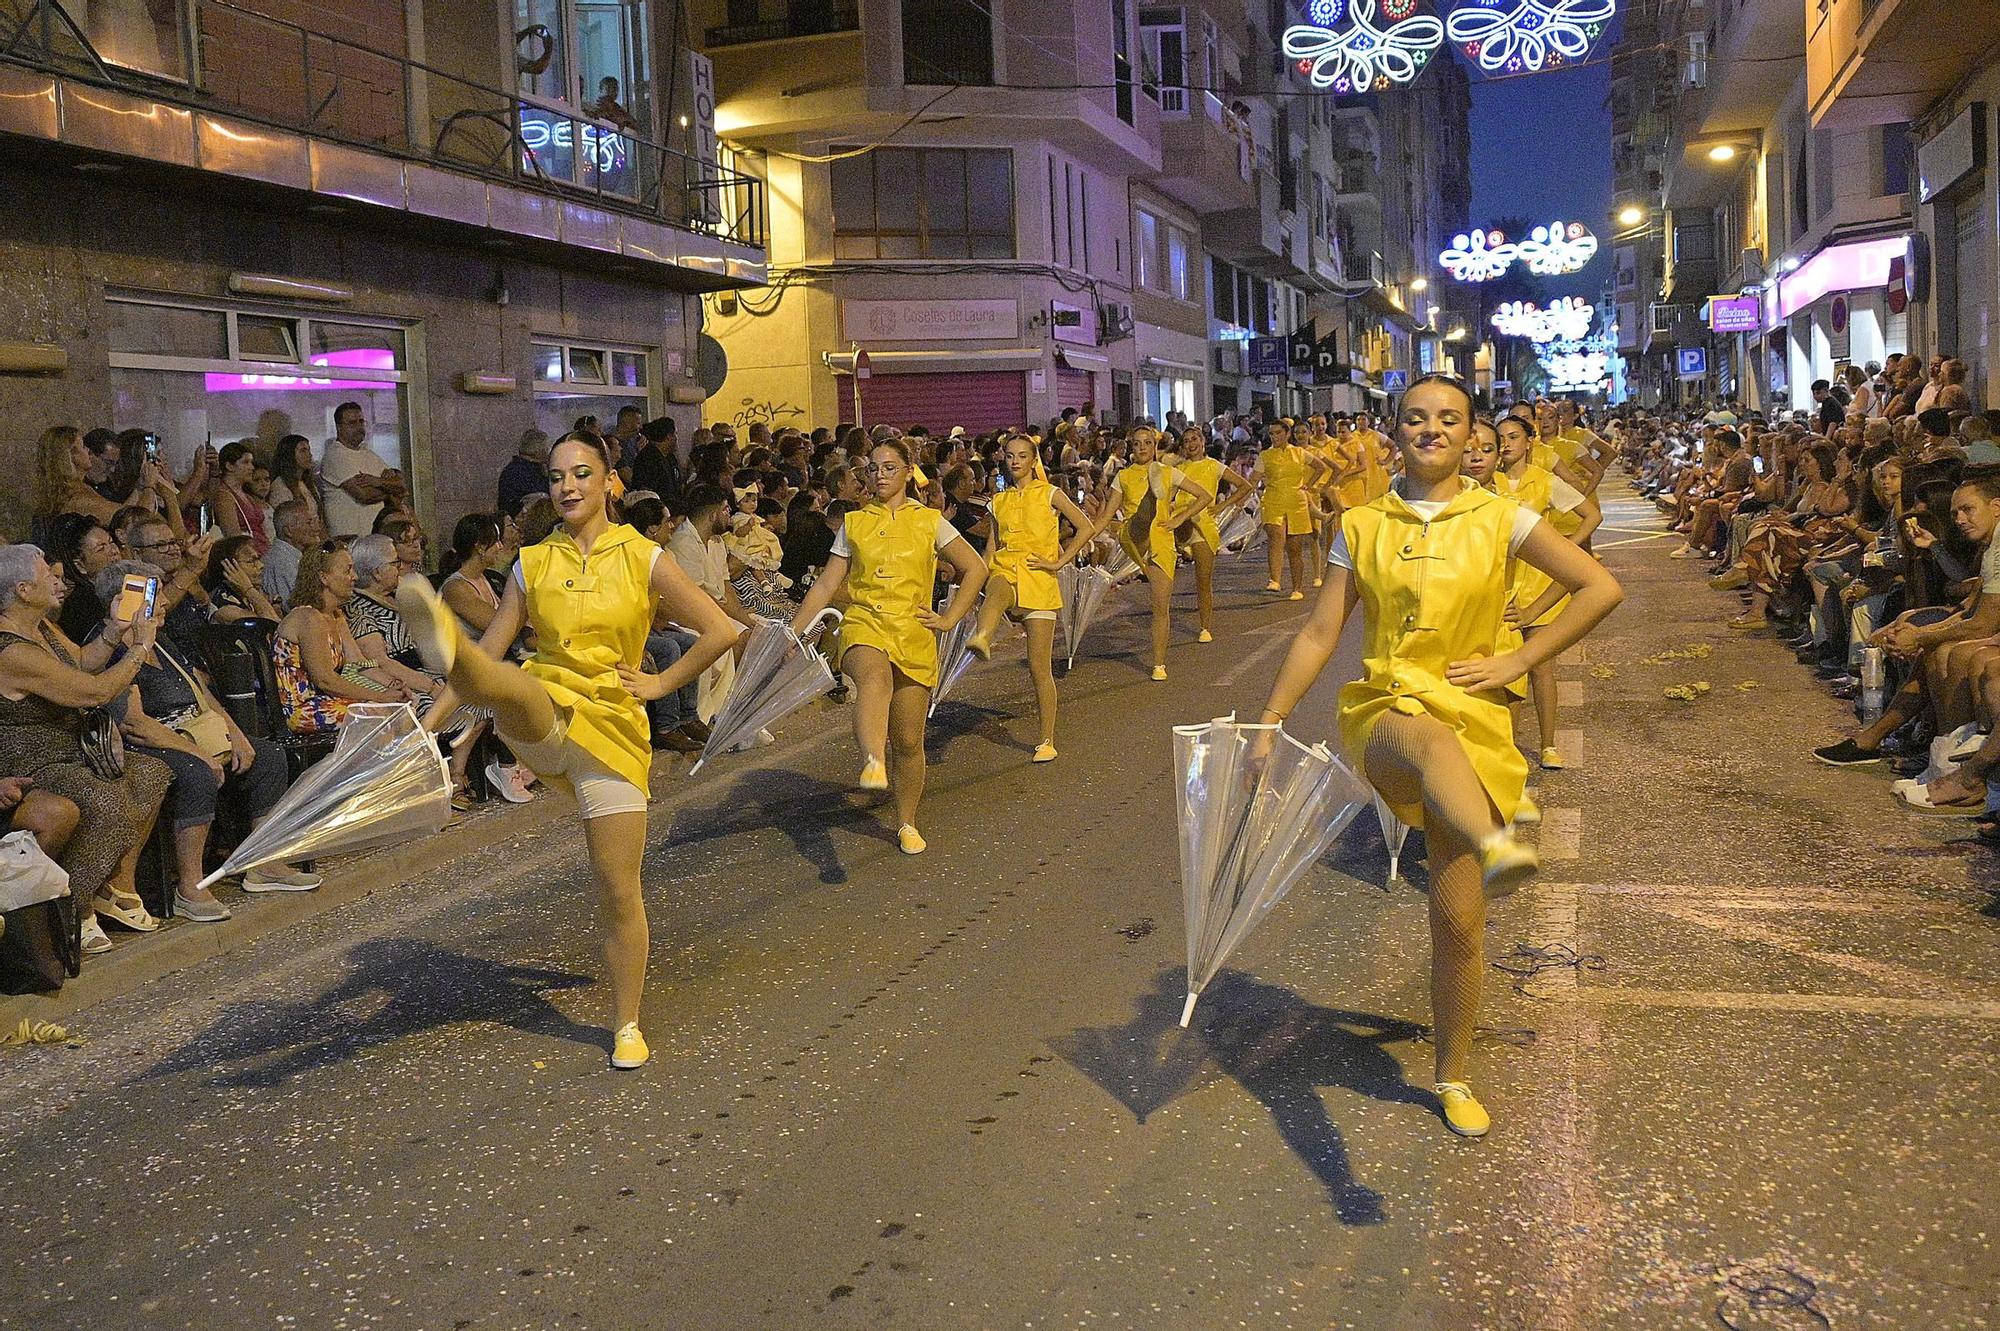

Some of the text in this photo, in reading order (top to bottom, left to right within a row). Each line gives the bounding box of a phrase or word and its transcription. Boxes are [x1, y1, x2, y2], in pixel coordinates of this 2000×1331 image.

[965, 306, 995, 321] Laura
[1263, 343, 1275, 358] P
[1684, 351, 1700, 370] P
